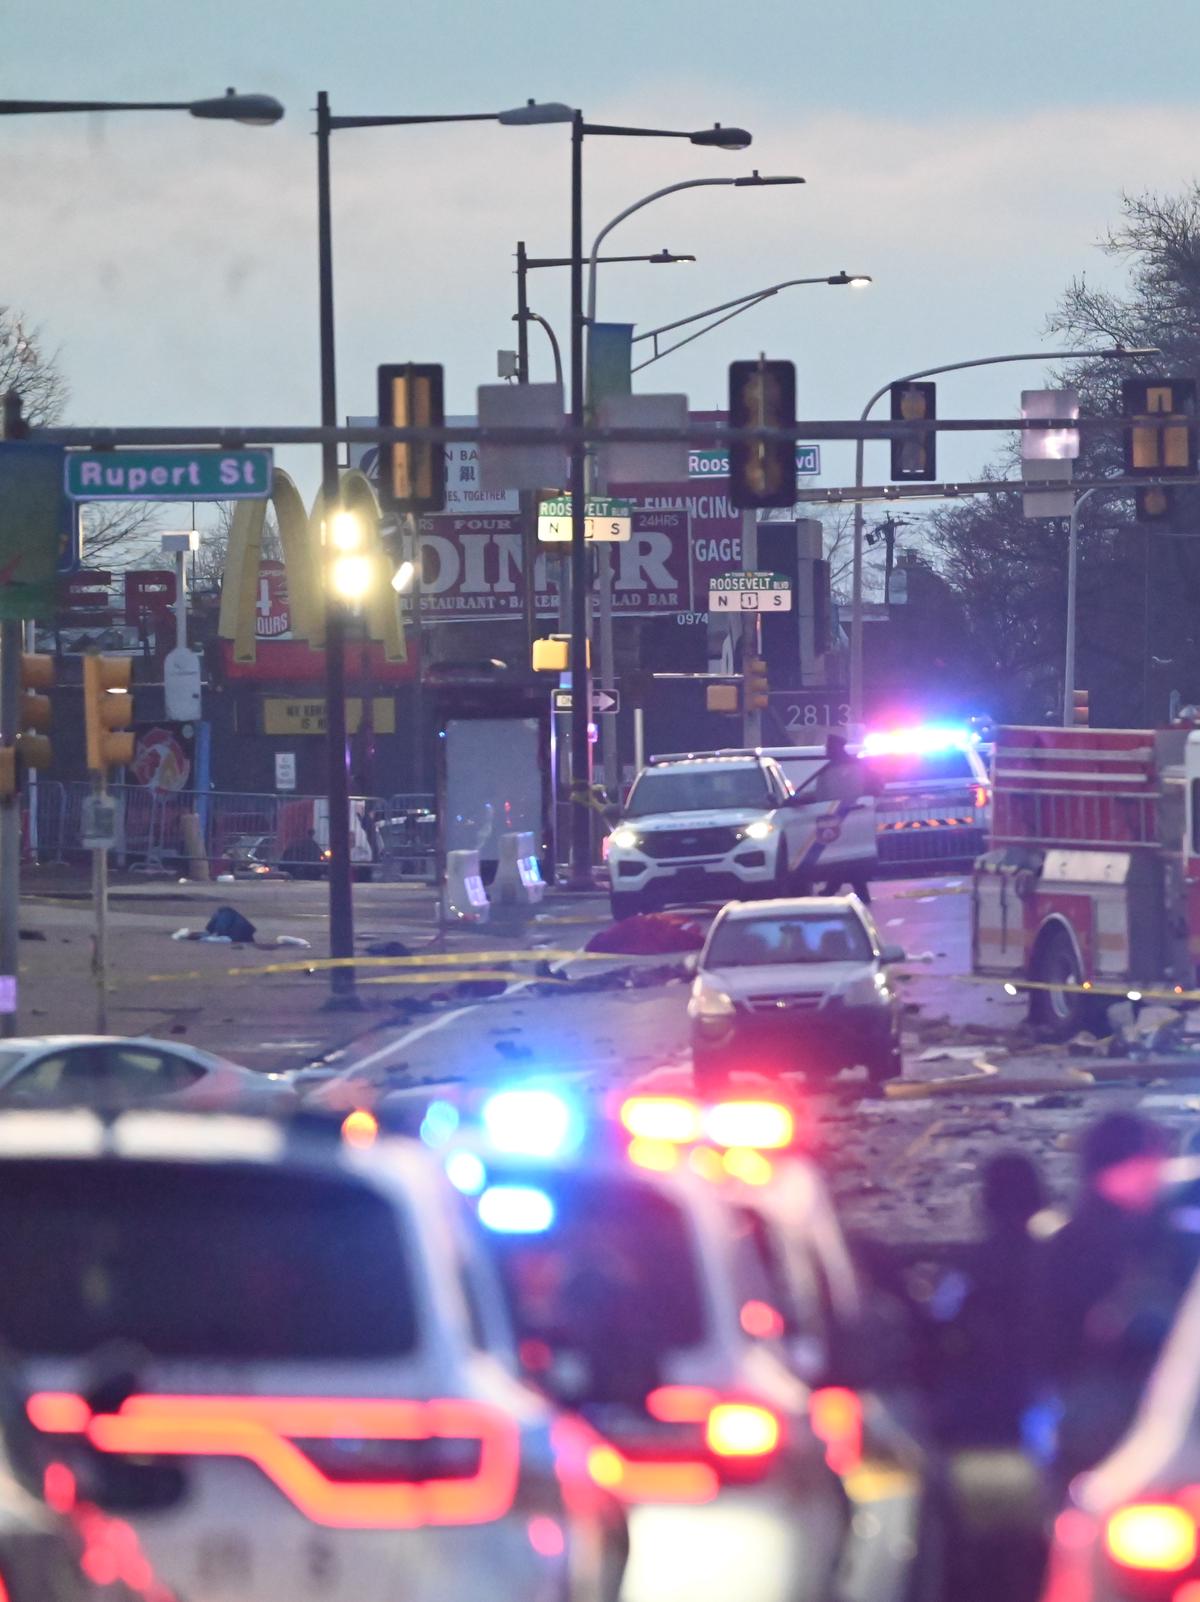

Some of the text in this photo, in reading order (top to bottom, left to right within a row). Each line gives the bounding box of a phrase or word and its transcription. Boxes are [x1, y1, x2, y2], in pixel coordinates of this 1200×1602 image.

[81, 458, 256, 491] Rupert St
[463, 490, 506, 501] TOGETHER
[453, 519, 512, 530] FOUR
[639, 514, 679, 527] 24HRS
[549, 522, 621, 535] N S
[709, 578, 771, 590] ROOSEVELT
[648, 593, 678, 606] BAR
[718, 595, 728, 607] N
[773, 595, 782, 606] S
[677, 612, 709, 625] 0974
[785, 704, 851, 730] 2813
